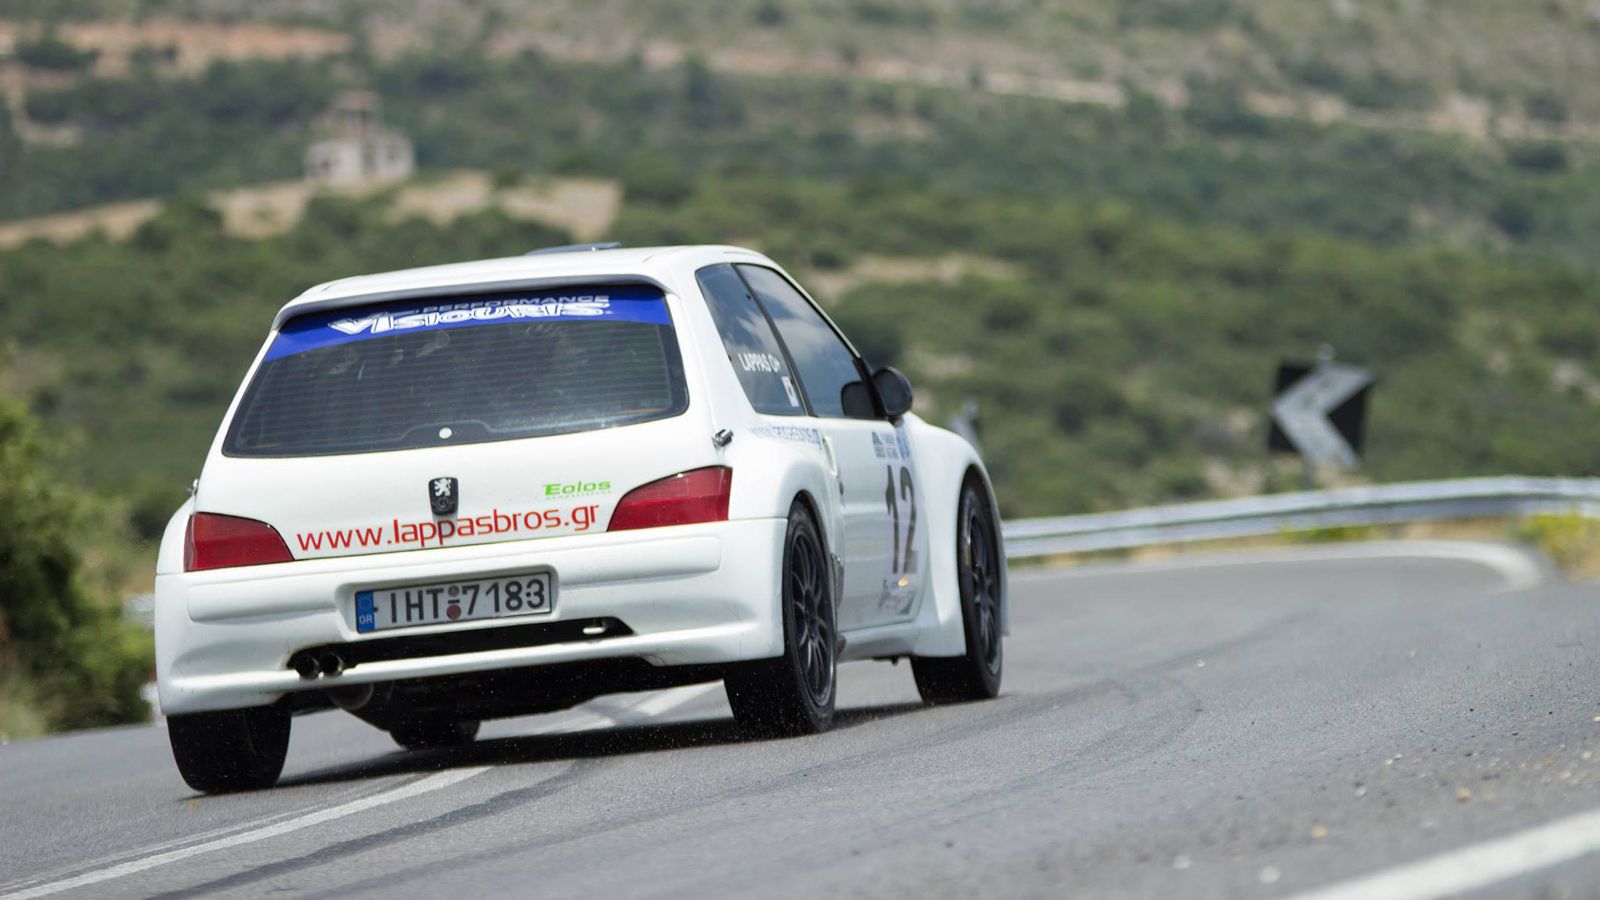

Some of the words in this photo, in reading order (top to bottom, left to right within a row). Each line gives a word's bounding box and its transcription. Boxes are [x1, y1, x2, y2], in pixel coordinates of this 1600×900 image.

[423, 295, 610, 313] PERFORMANCE
[737, 353, 772, 373] LAPPAS
[544, 480, 611, 496] Eolos
[297, 503, 600, 552] www.lappasbros.gr
[885, 464, 918, 574] 12
[358, 614, 373, 625] GR
